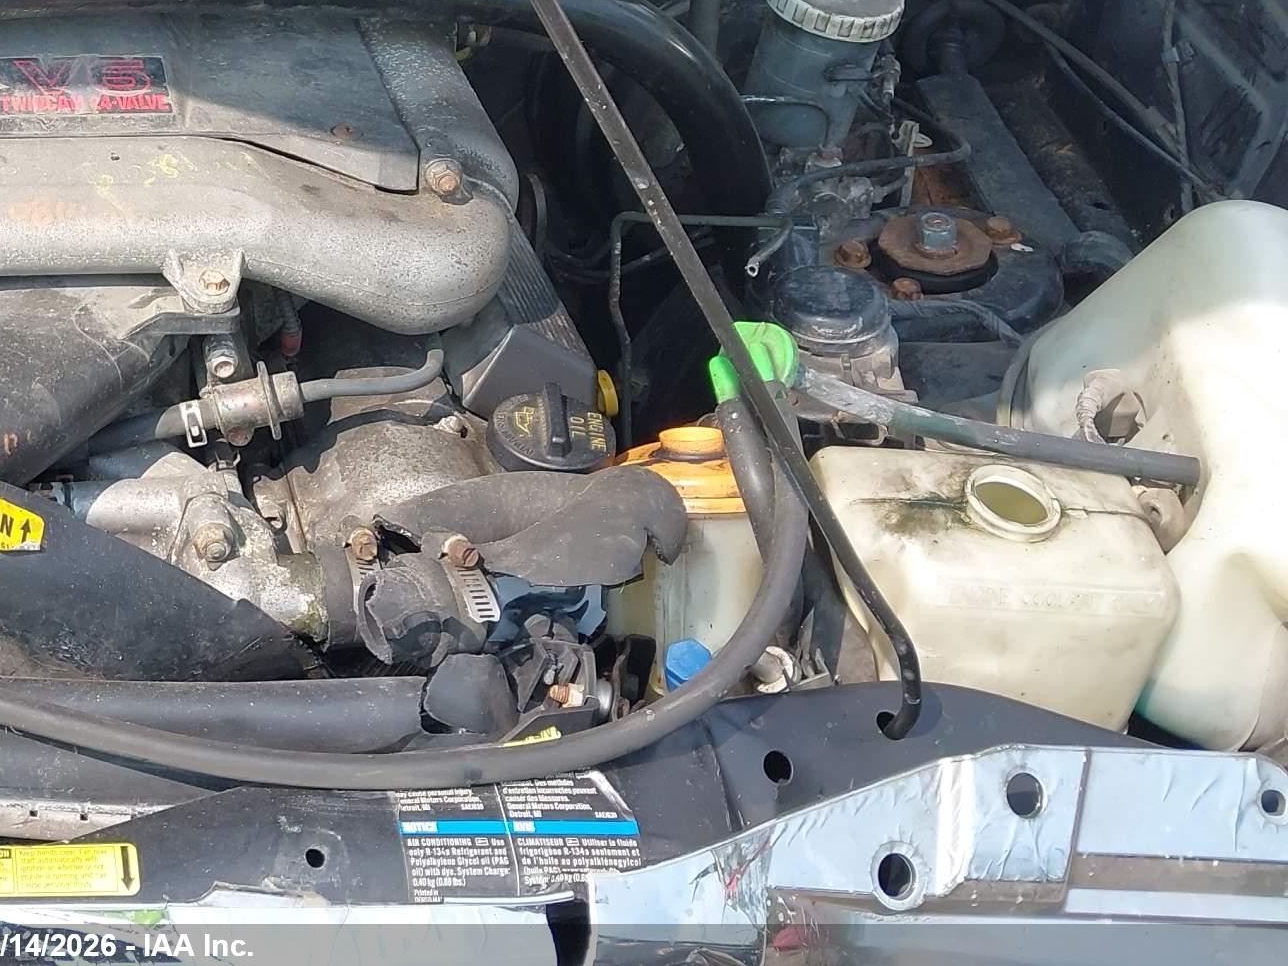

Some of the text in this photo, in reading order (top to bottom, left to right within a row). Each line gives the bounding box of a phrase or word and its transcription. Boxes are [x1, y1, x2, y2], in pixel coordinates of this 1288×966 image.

[570, 416, 587, 439] OIL
[587, 412, 607, 453] ENGINE
[408, 838, 420, 846] AIR
[421, 838, 472, 846] CONDITIONING
[517, 838, 564, 846] CLIMATISEUR
[617, 838, 637, 846] fluide
[409, 848, 424, 857] only
[452, 848, 489, 857] Refrigerant
[563, 848, 590, 856] R-134a
[592, 848, 630, 856] seulement
[411, 857, 455, 867] Polyalkylene
[457, 857, 479, 866] Glycol
[522, 857, 531, 865] de
[425, 867, 440, 876] with
[458, 867, 482, 877] System
